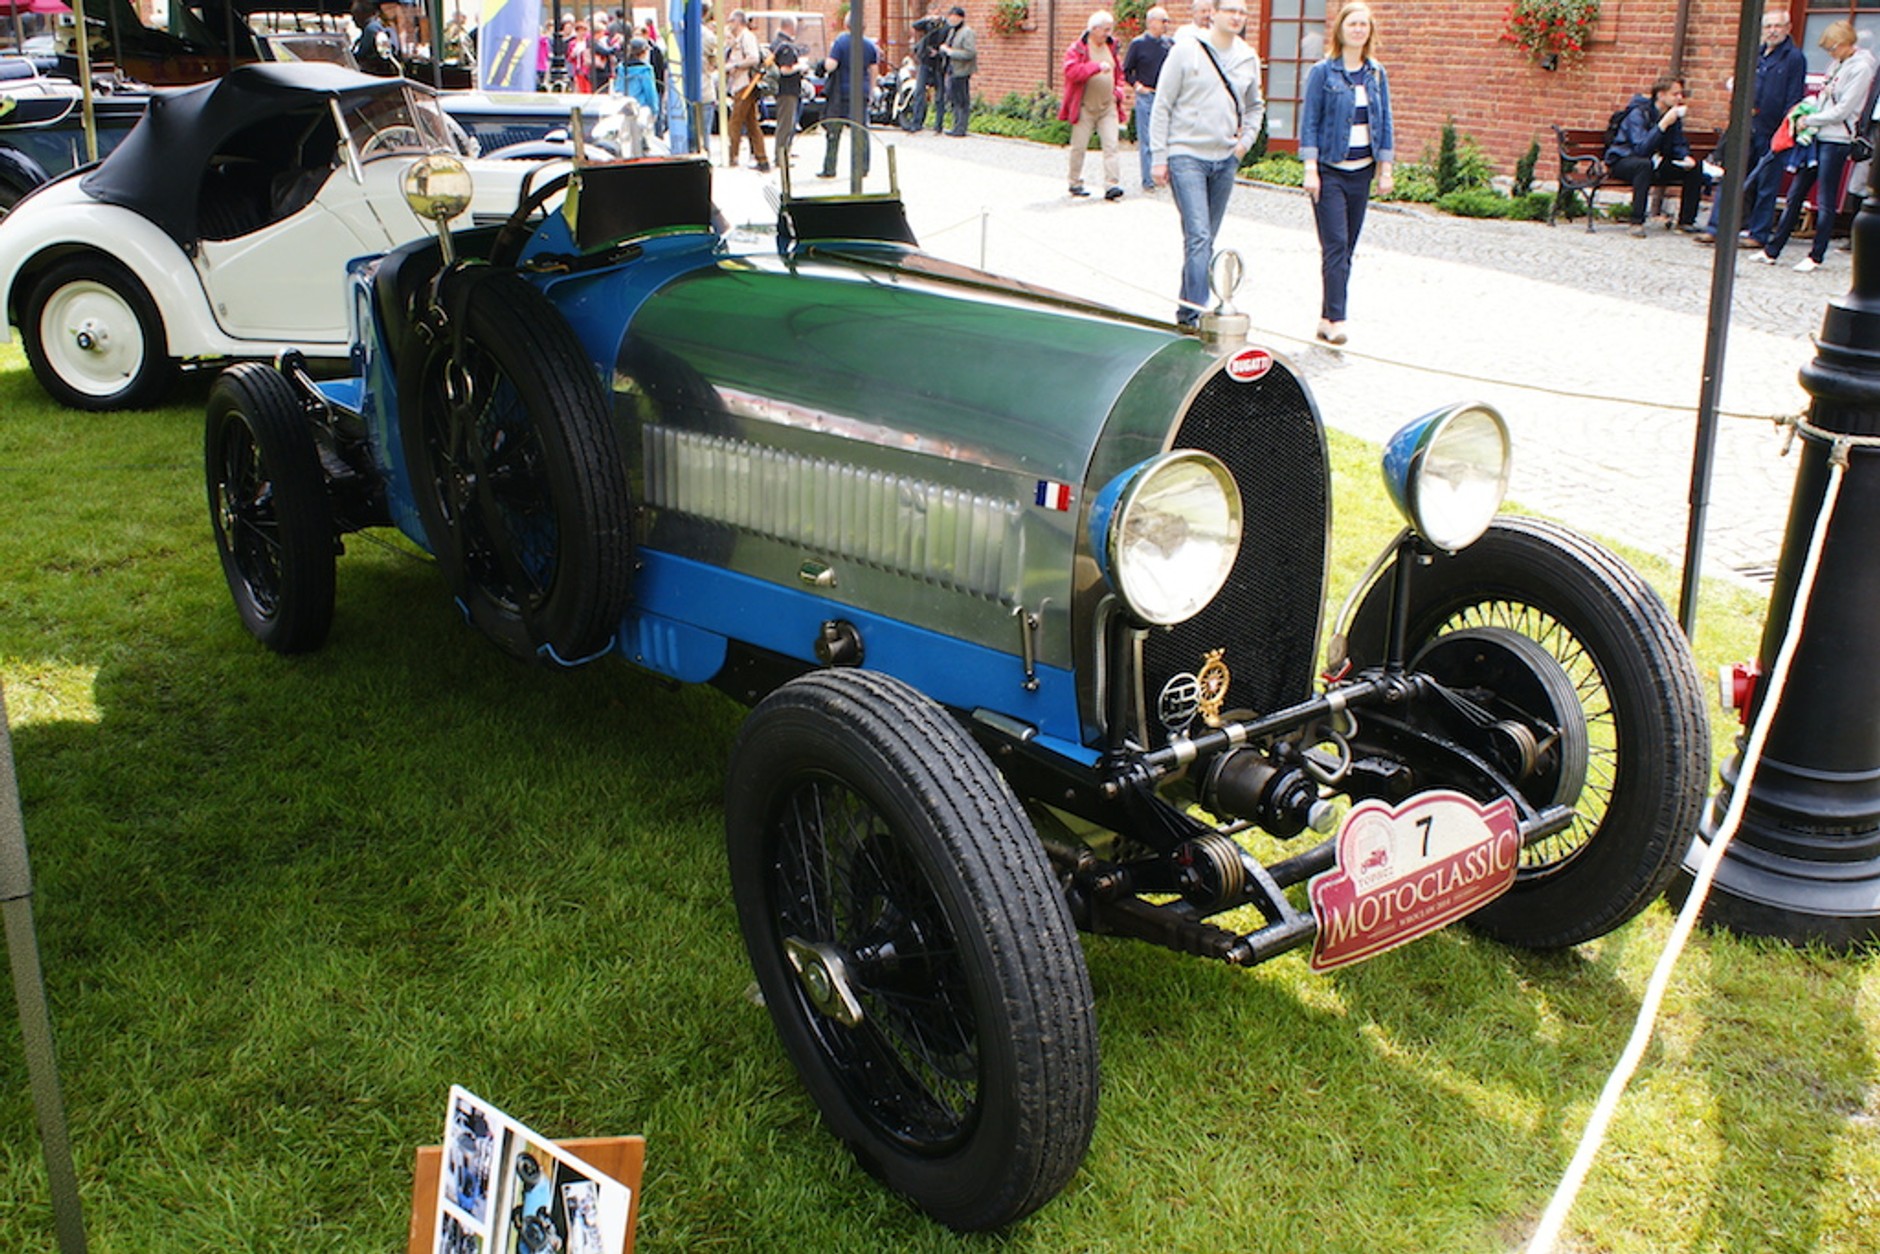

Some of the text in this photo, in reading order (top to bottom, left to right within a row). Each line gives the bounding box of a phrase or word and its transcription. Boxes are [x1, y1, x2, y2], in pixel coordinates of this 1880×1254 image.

[1231, 356, 1271, 373] BUGATTI
[1415, 815, 1432, 857] 7
[1327, 829, 1513, 949] MOTOCLASSIC
